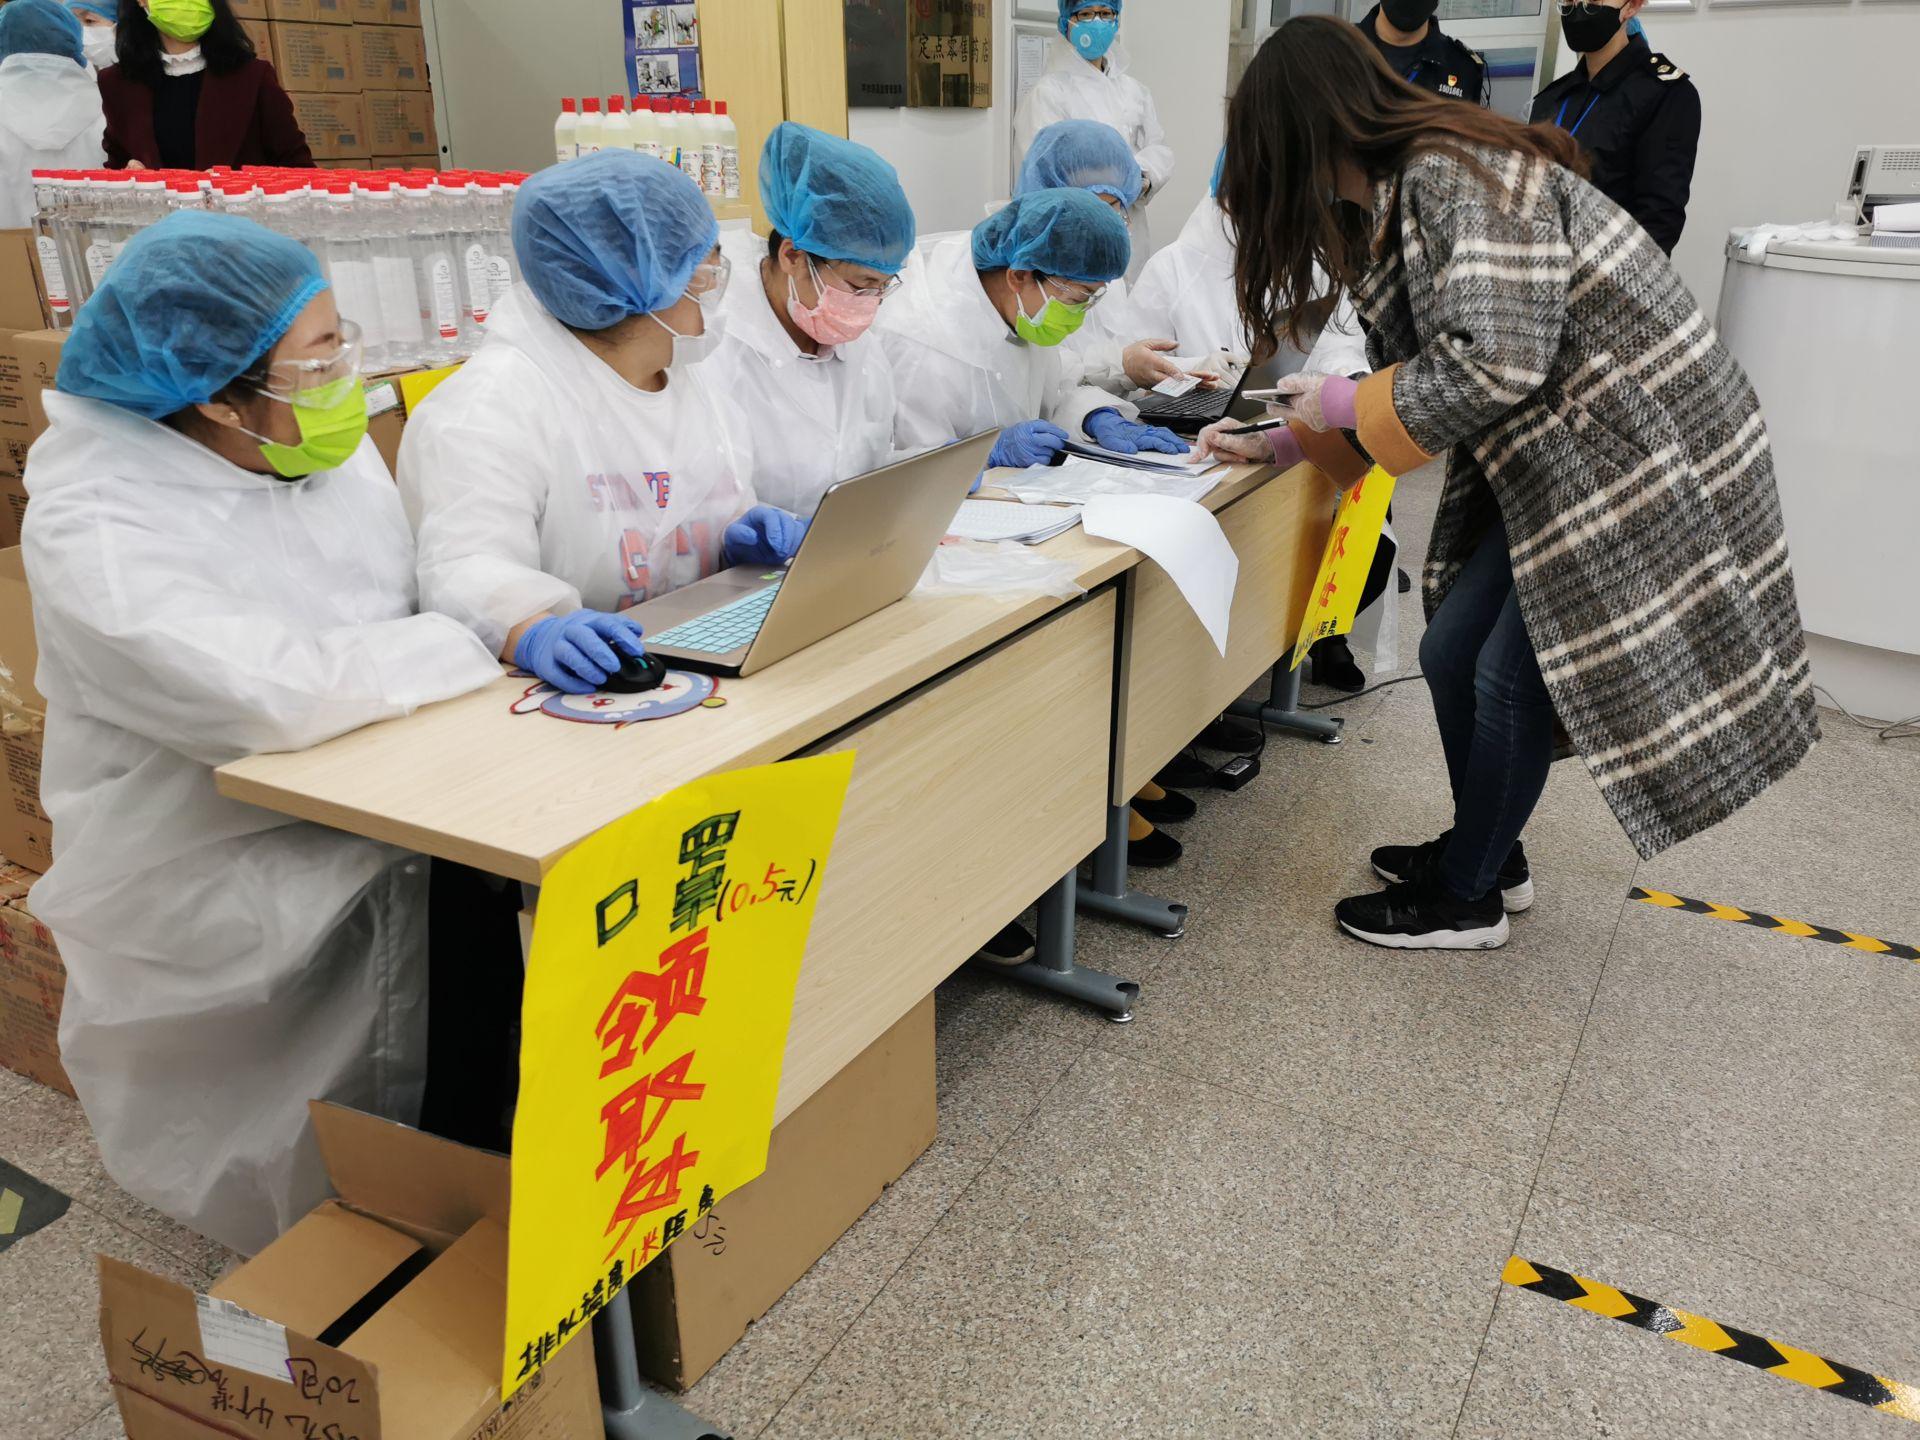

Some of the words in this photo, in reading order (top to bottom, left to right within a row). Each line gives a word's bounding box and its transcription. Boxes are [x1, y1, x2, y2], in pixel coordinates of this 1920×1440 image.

[596, 810, 741, 948] 口罩
[594, 926, 710, 1265] 领取处
